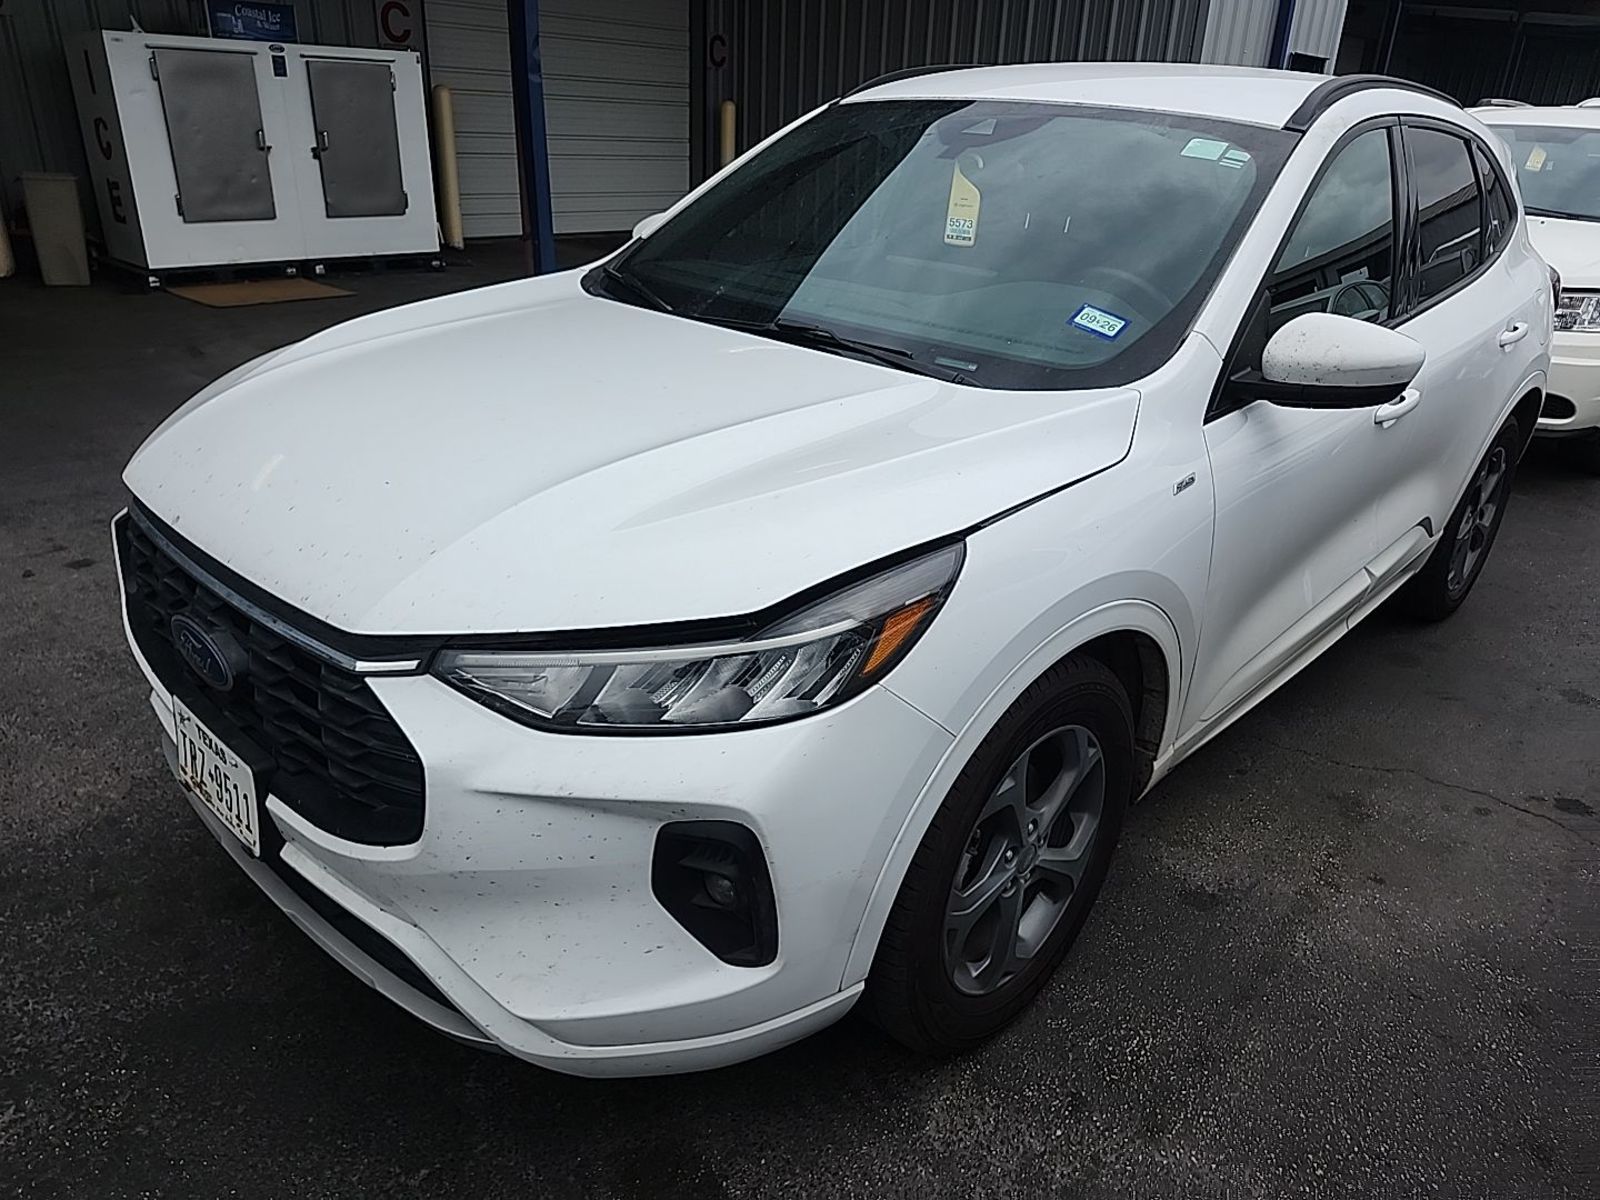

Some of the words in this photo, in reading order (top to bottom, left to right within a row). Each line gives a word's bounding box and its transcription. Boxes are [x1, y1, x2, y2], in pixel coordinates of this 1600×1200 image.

[381, 1, 411, 43] C
[709, 34, 727, 67] C
[84, 49, 127, 225] ICE
[949, 217, 973, 229] 5573
[195, 723, 227, 765] TEXAS
